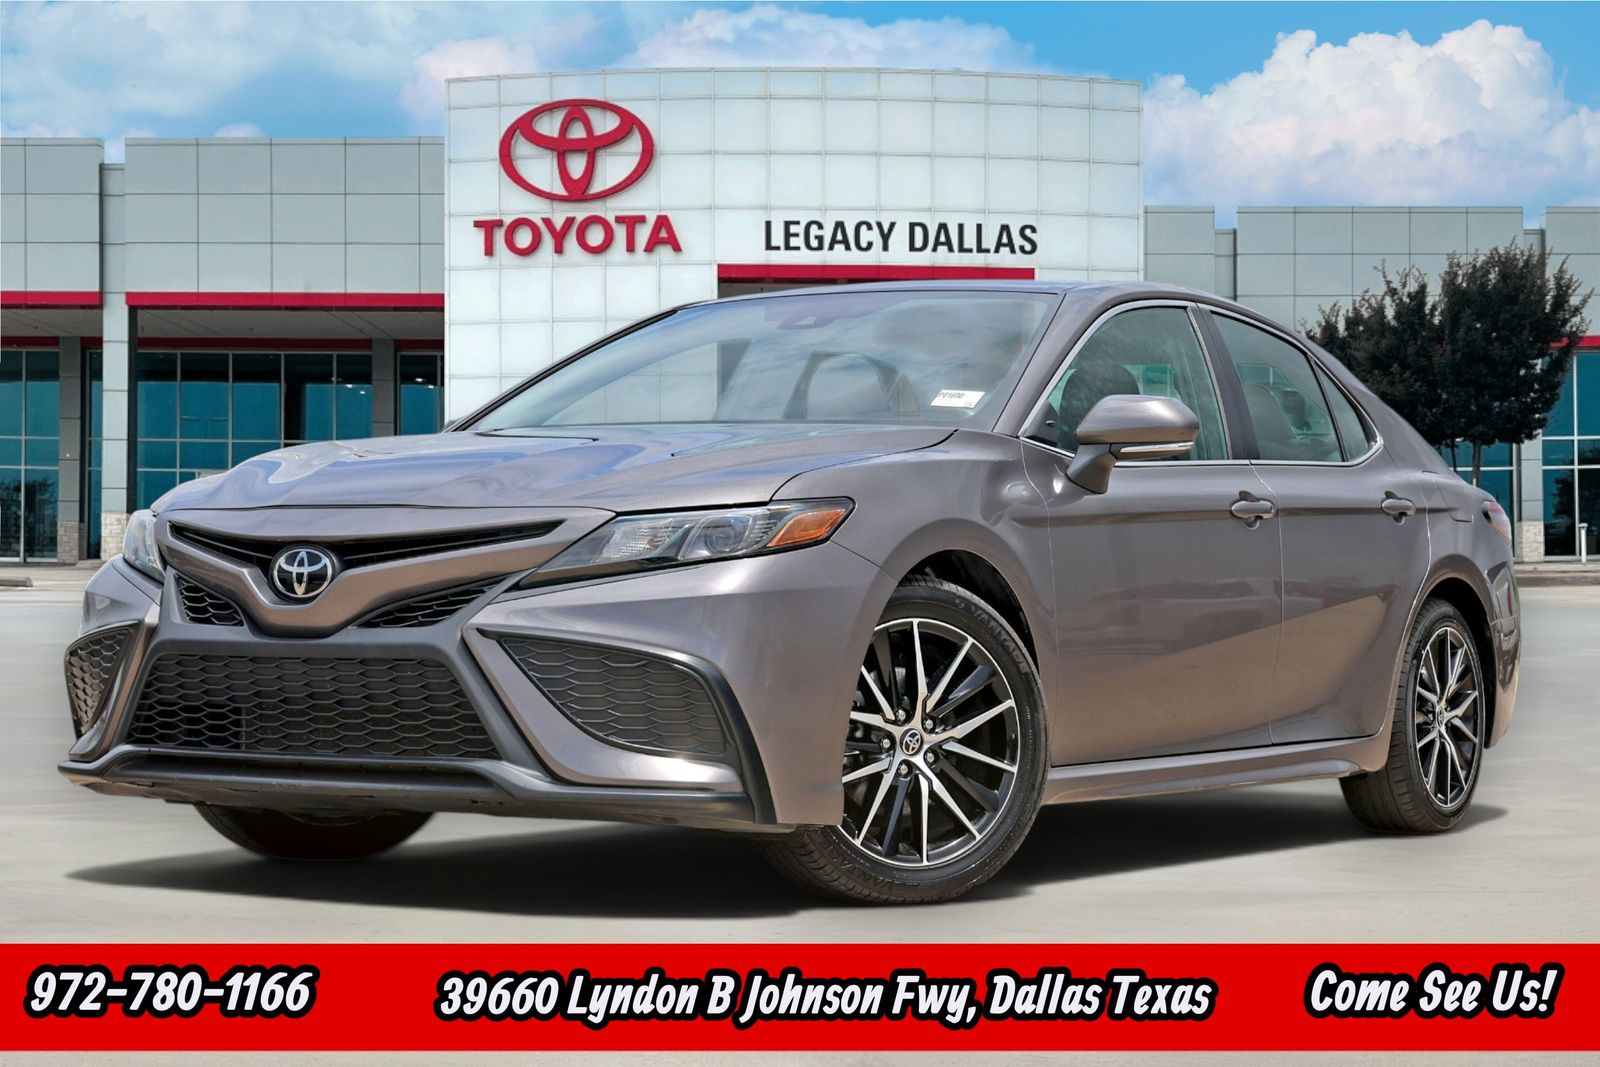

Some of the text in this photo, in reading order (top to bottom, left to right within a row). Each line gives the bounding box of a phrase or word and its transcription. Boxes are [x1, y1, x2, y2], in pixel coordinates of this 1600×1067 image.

[474, 214, 682, 257] TOYOTA
[765, 220, 1038, 255] LEGACY DALLAS
